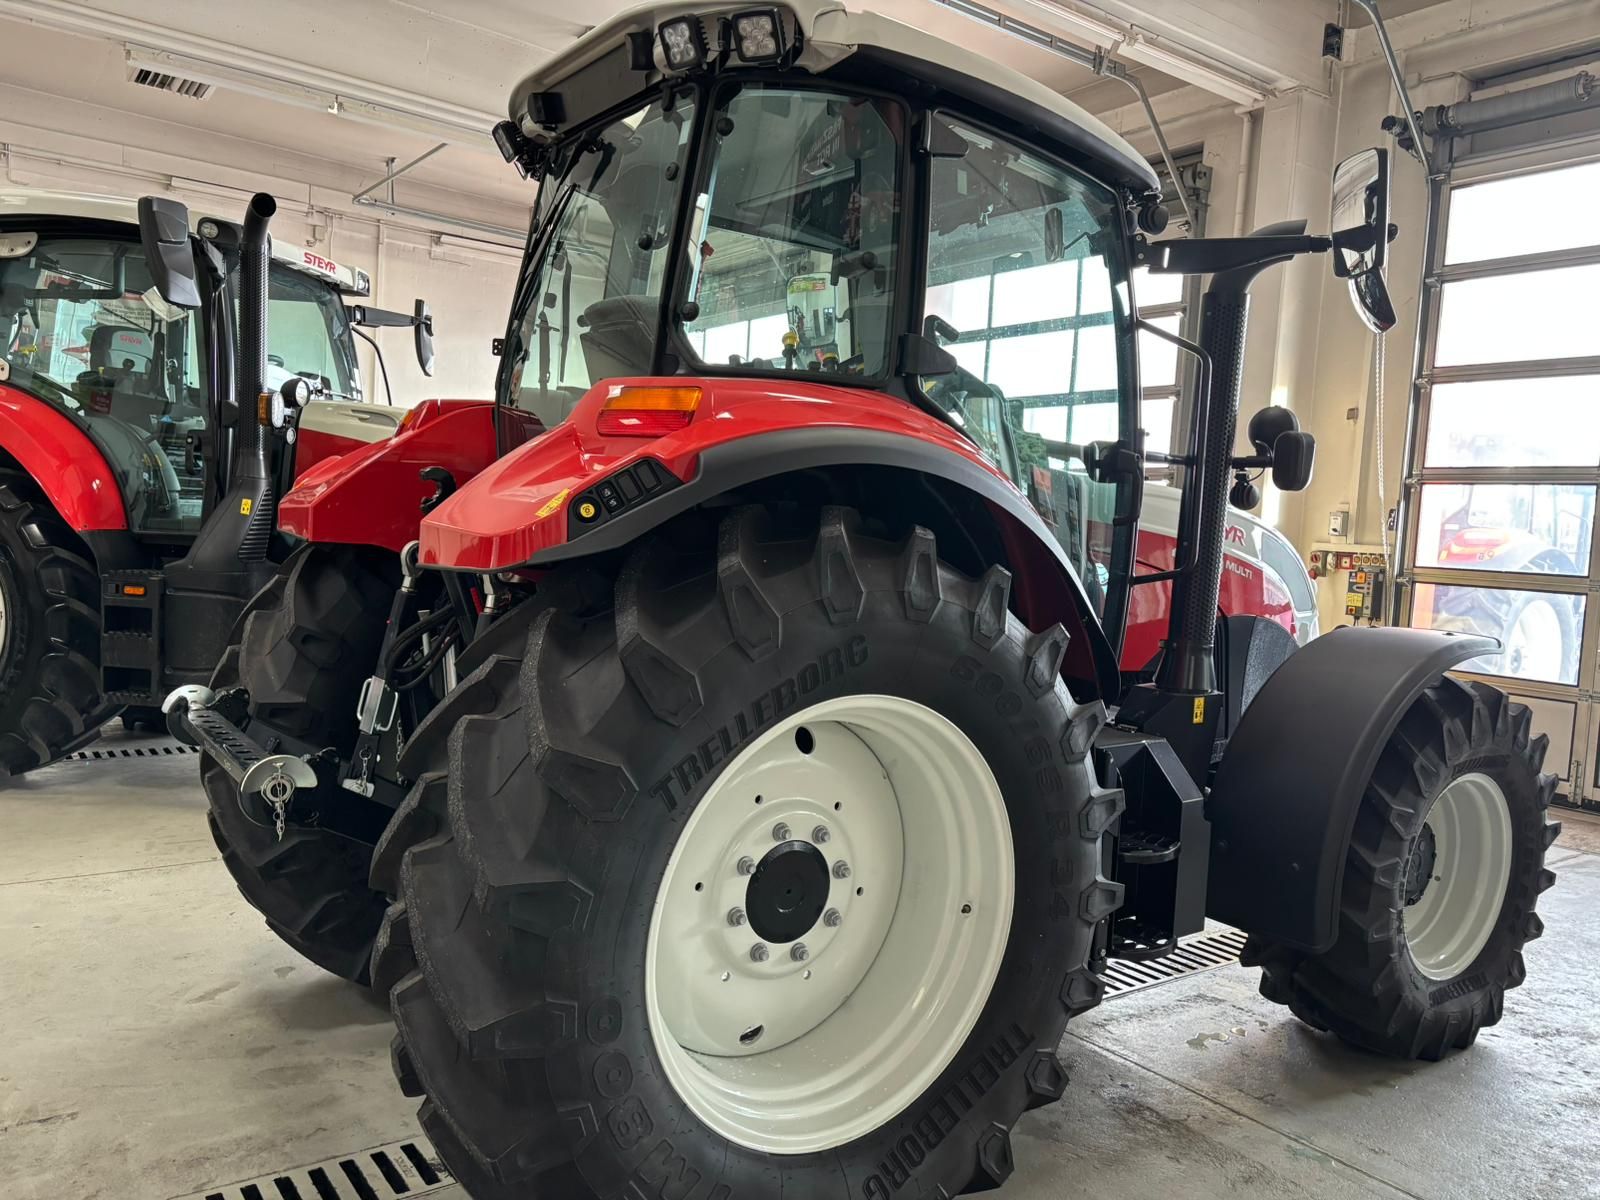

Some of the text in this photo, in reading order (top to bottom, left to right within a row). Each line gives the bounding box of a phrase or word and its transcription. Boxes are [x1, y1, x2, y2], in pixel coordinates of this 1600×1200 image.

[304, 252, 336, 275] STEYR
[1225, 559, 1253, 580] MULTI
[648, 634, 869, 814] TRELLEBORG
[862, 1022, 1036, 1200] TRELLEBORG
